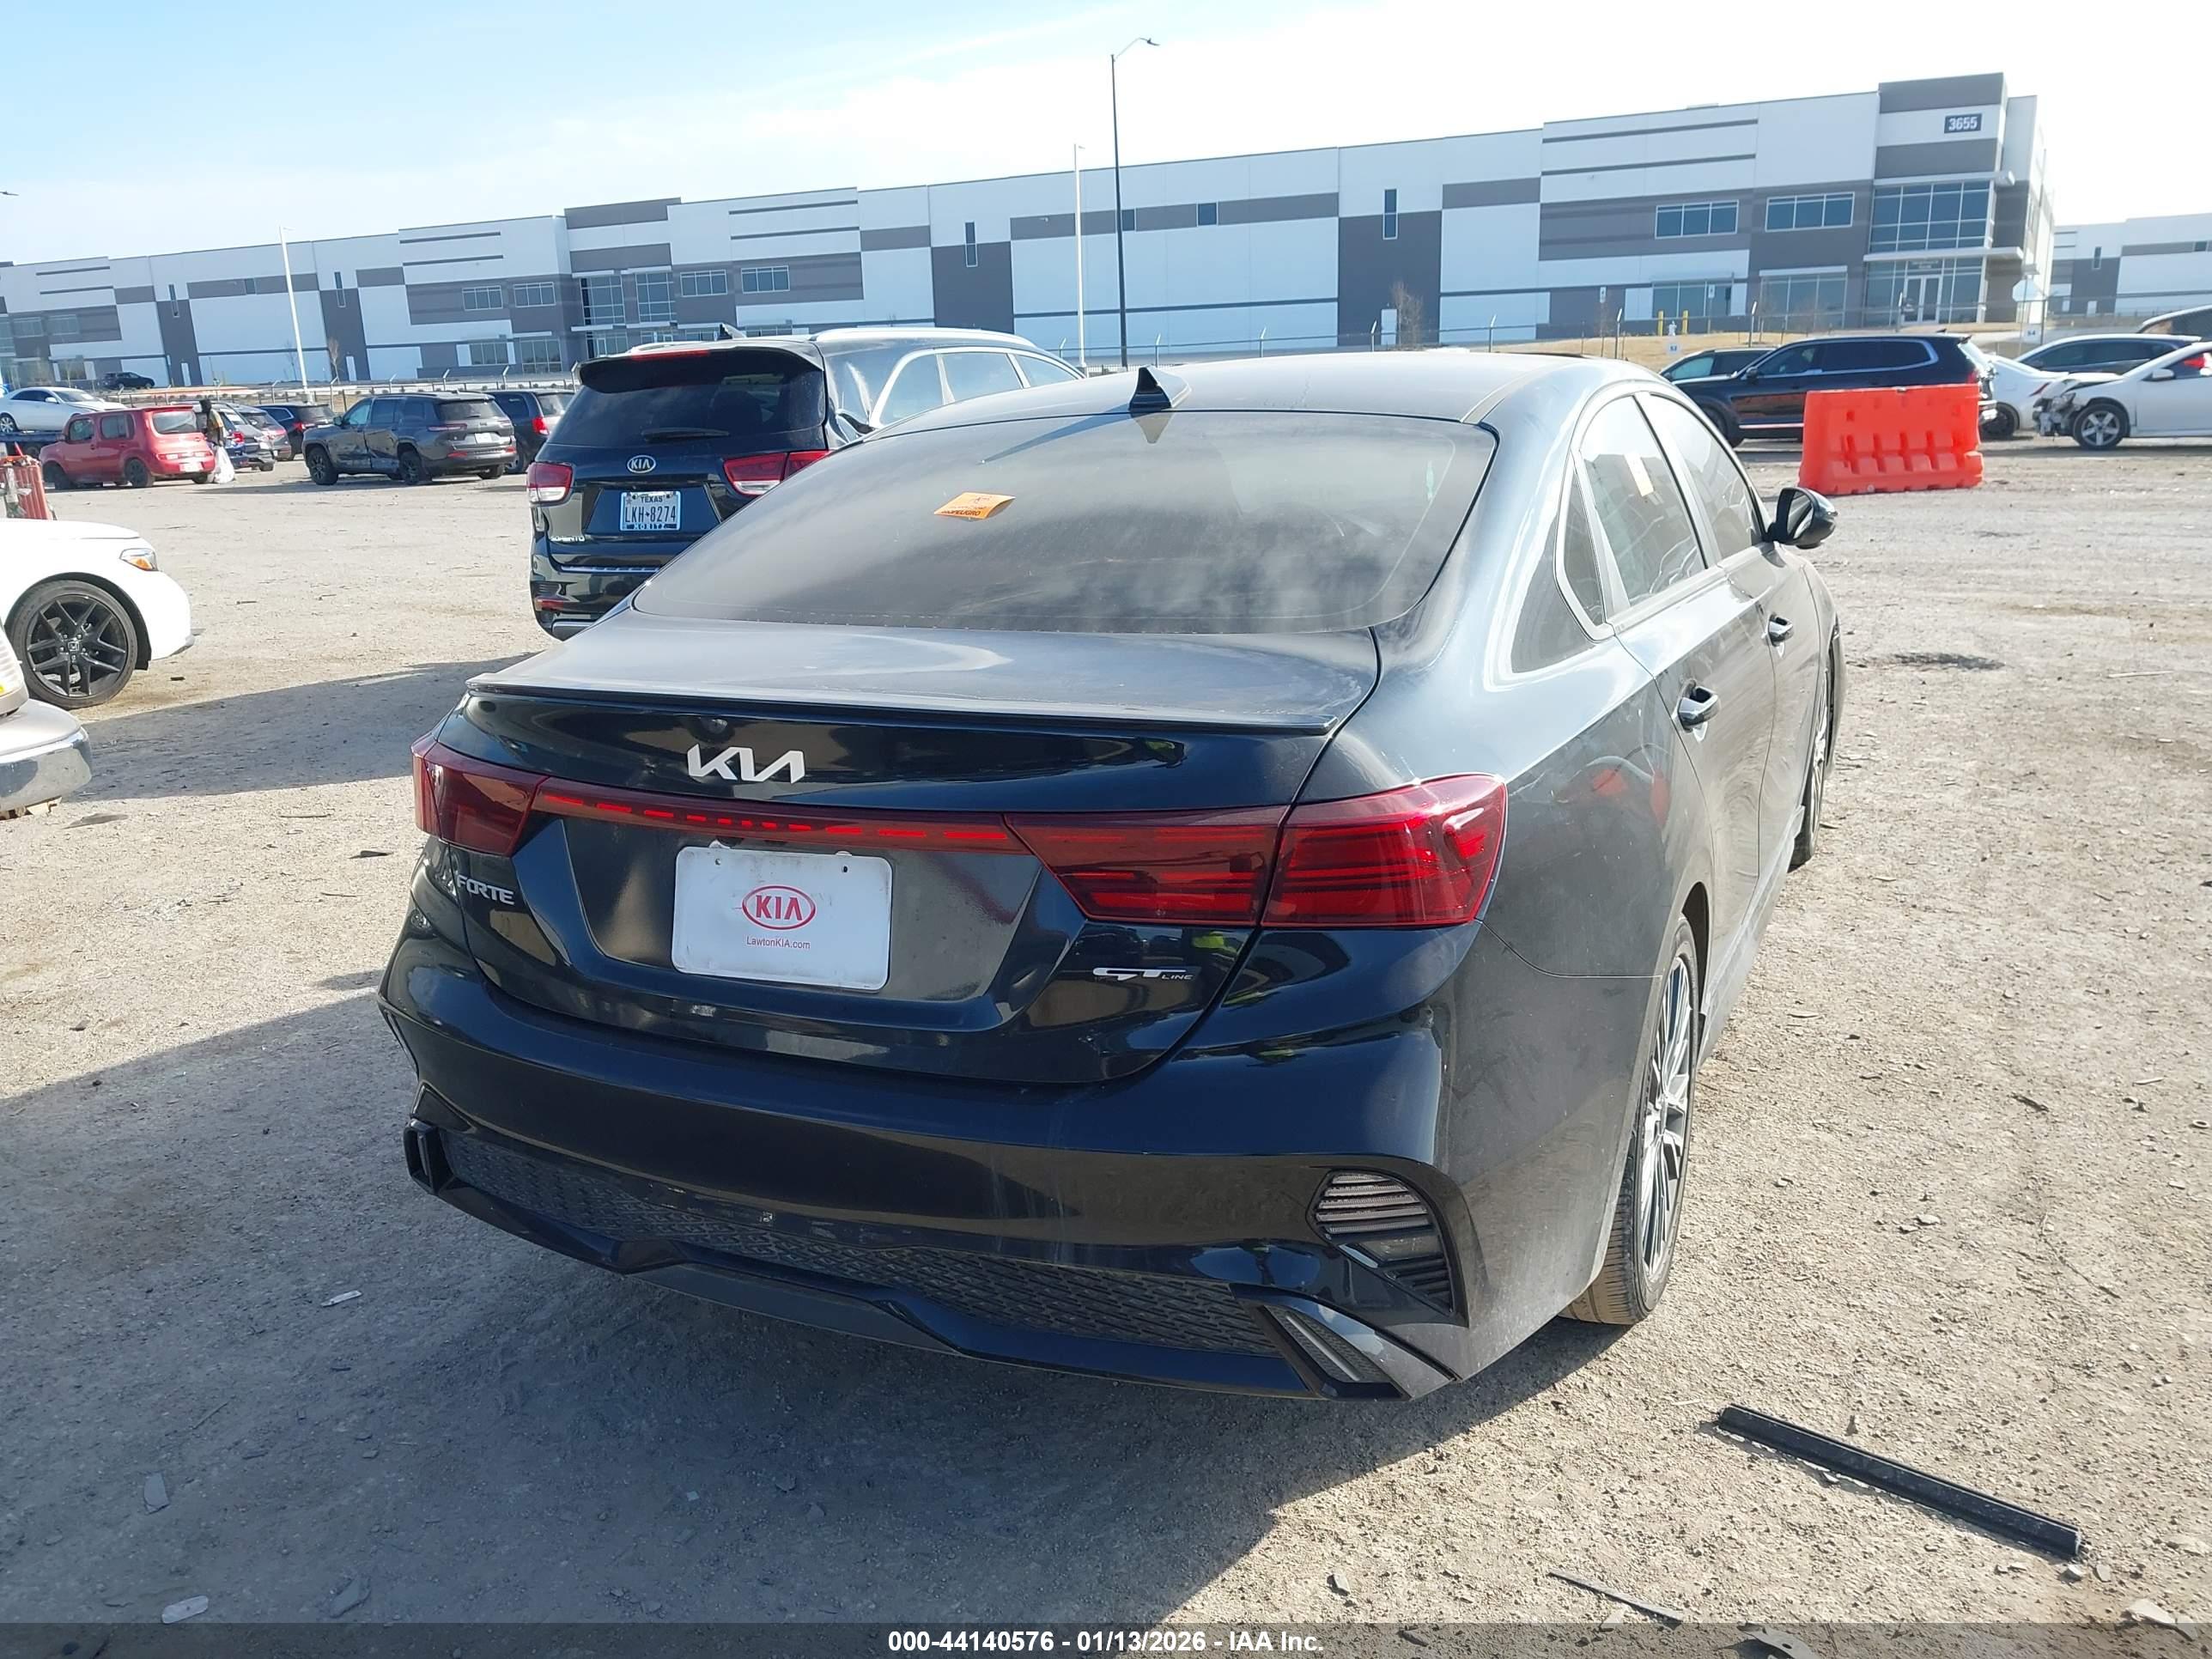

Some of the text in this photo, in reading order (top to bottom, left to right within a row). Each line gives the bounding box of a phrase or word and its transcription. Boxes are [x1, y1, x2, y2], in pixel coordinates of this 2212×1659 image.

[1948, 116, 1978, 131] 3655
[630, 459, 651, 470] KIA
[686, 743, 805, 784] KIA
[455, 874, 515, 906] FORTE
[755, 895, 803, 921] KIA
[746, 935, 811, 950] LawtonKIA.com
[1092, 967, 1187, 981] GT
